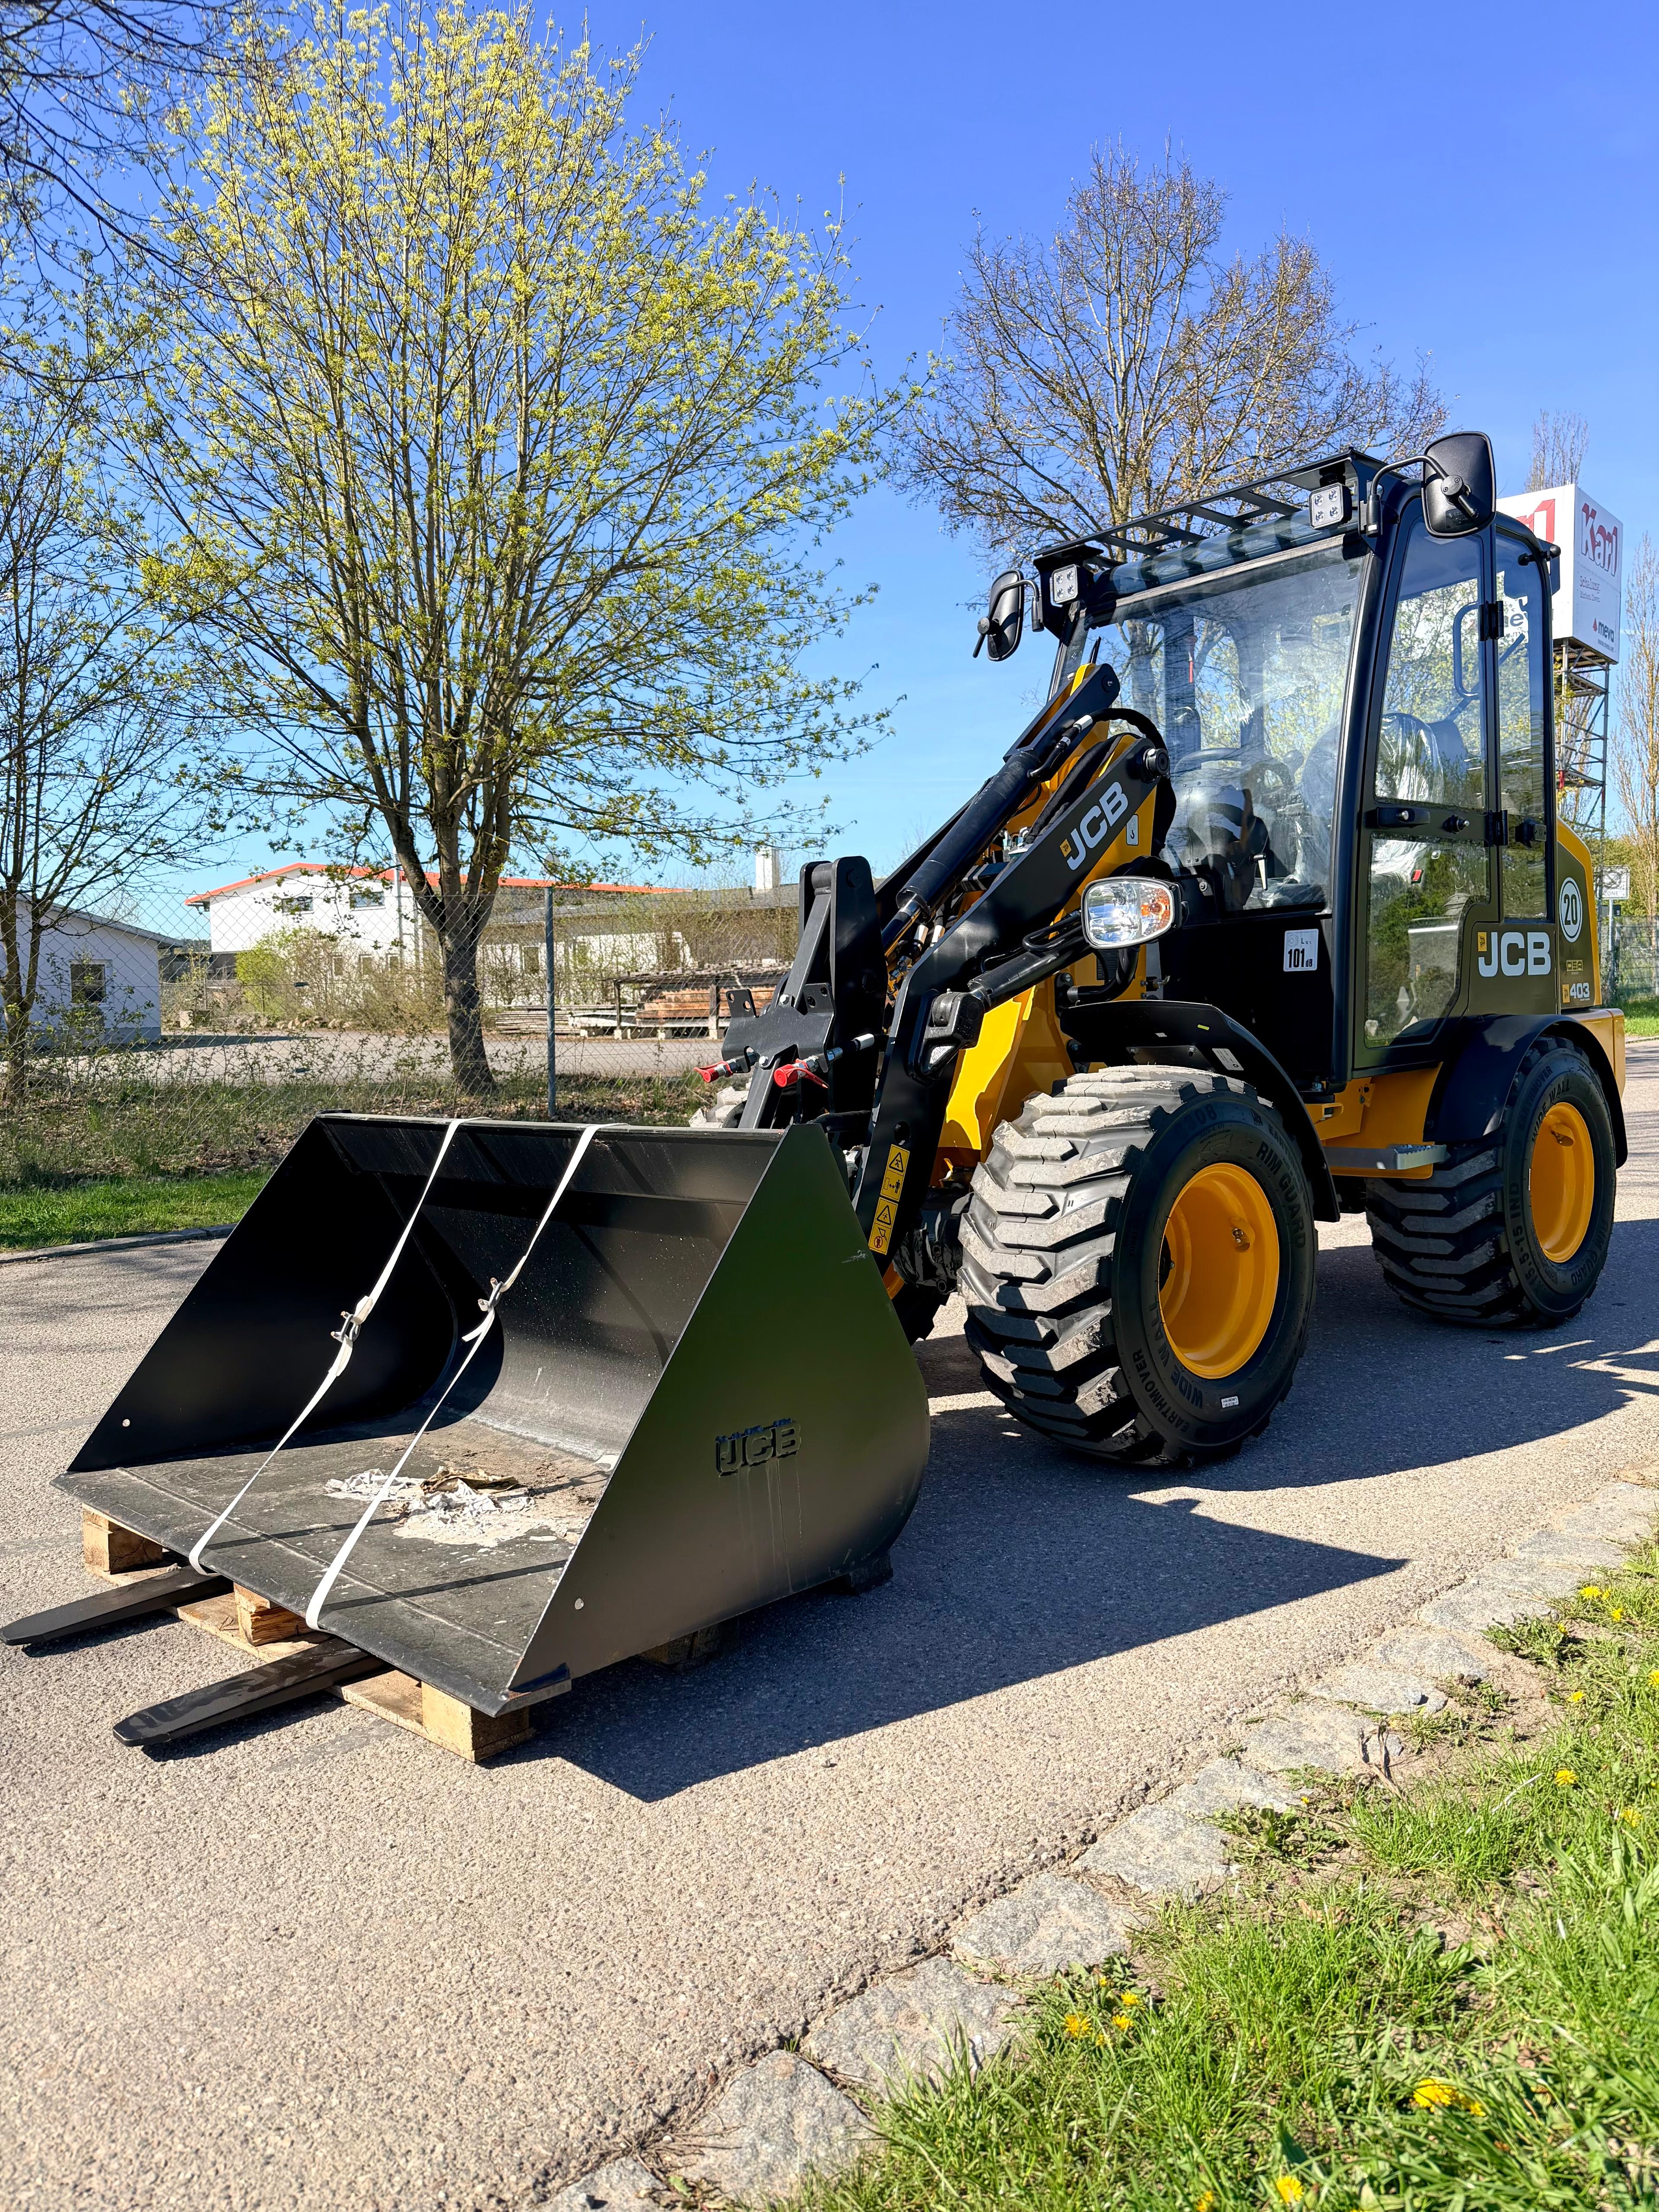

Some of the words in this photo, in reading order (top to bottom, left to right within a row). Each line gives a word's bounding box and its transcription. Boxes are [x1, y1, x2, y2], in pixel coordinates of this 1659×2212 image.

[1581, 503, 1618, 577] Karl
[1599, 621, 1614, 643] meva
[1066, 782, 1128, 870] JCB
[1564, 893, 1578, 925] 20
[1288, 948, 1305, 968] 101
[1306, 959, 1313, 967] dB
[1478, 931, 1551, 977] JCB
[1570, 982, 1590, 998] 403
[1256, 1141, 1283, 1175] RIM
[1279, 1172, 1306, 1249] GUARD
[1148, 1303, 1170, 1367] WALL
[1132, 1348, 1189, 1432] EARTHMOVER
[1170, 1365, 1204, 1409] WIDE
[715, 1418, 802, 1478] JCB
